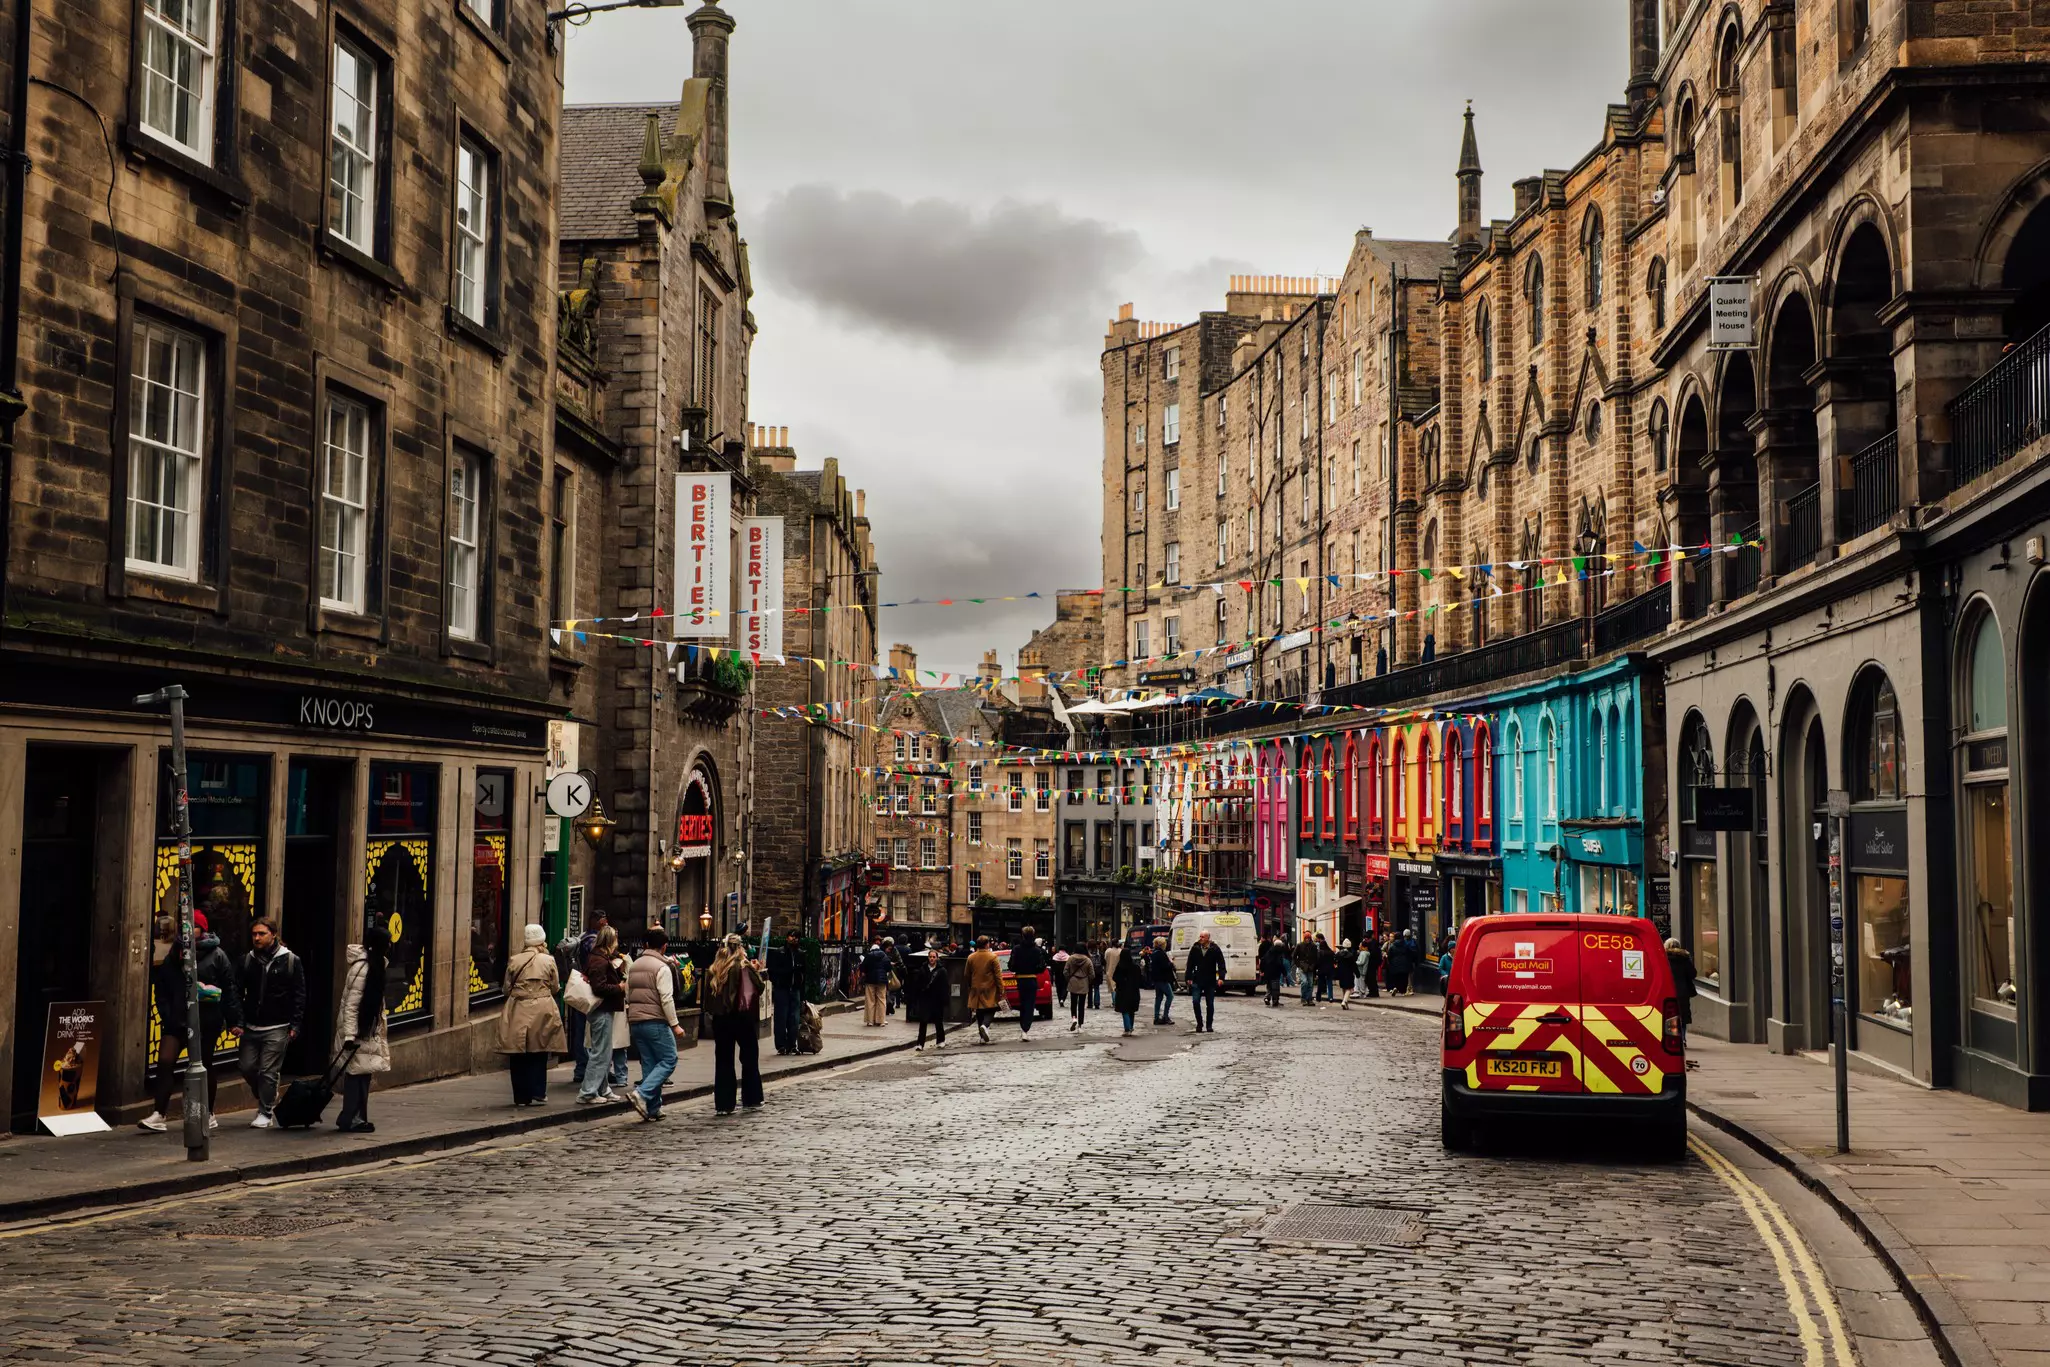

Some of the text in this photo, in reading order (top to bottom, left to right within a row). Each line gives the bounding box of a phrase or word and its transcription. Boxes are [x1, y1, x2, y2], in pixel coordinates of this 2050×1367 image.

[1716, 310, 1748, 318] Meeting
[691, 484, 706, 625] BERTIES
[748, 527, 762, 650] BERTIES
[300, 697, 374, 729] KNOOPS
[1981, 745, 2003, 766] TWEED
[567, 785, 583, 806] K
[1398, 862, 1406, 871] THE
[1406, 863, 1420, 873] WHISKY
[1421, 865, 1432, 874] SHOP
[394, 920, 401, 934] K
[1583, 934, 1634, 950] CE58
[1501, 960, 1549, 971] Royal Mail
[73, 1008, 86, 1016] ADD
[59, 1015, 94, 1024] THE WORKS
[66, 1022, 86, 1031] TO ANY
[57, 1030, 75, 1039] DRINK
[1494, 1061, 1557, 1075] KS20 FRJ
[1635, 1062, 1646, 1070] 70
